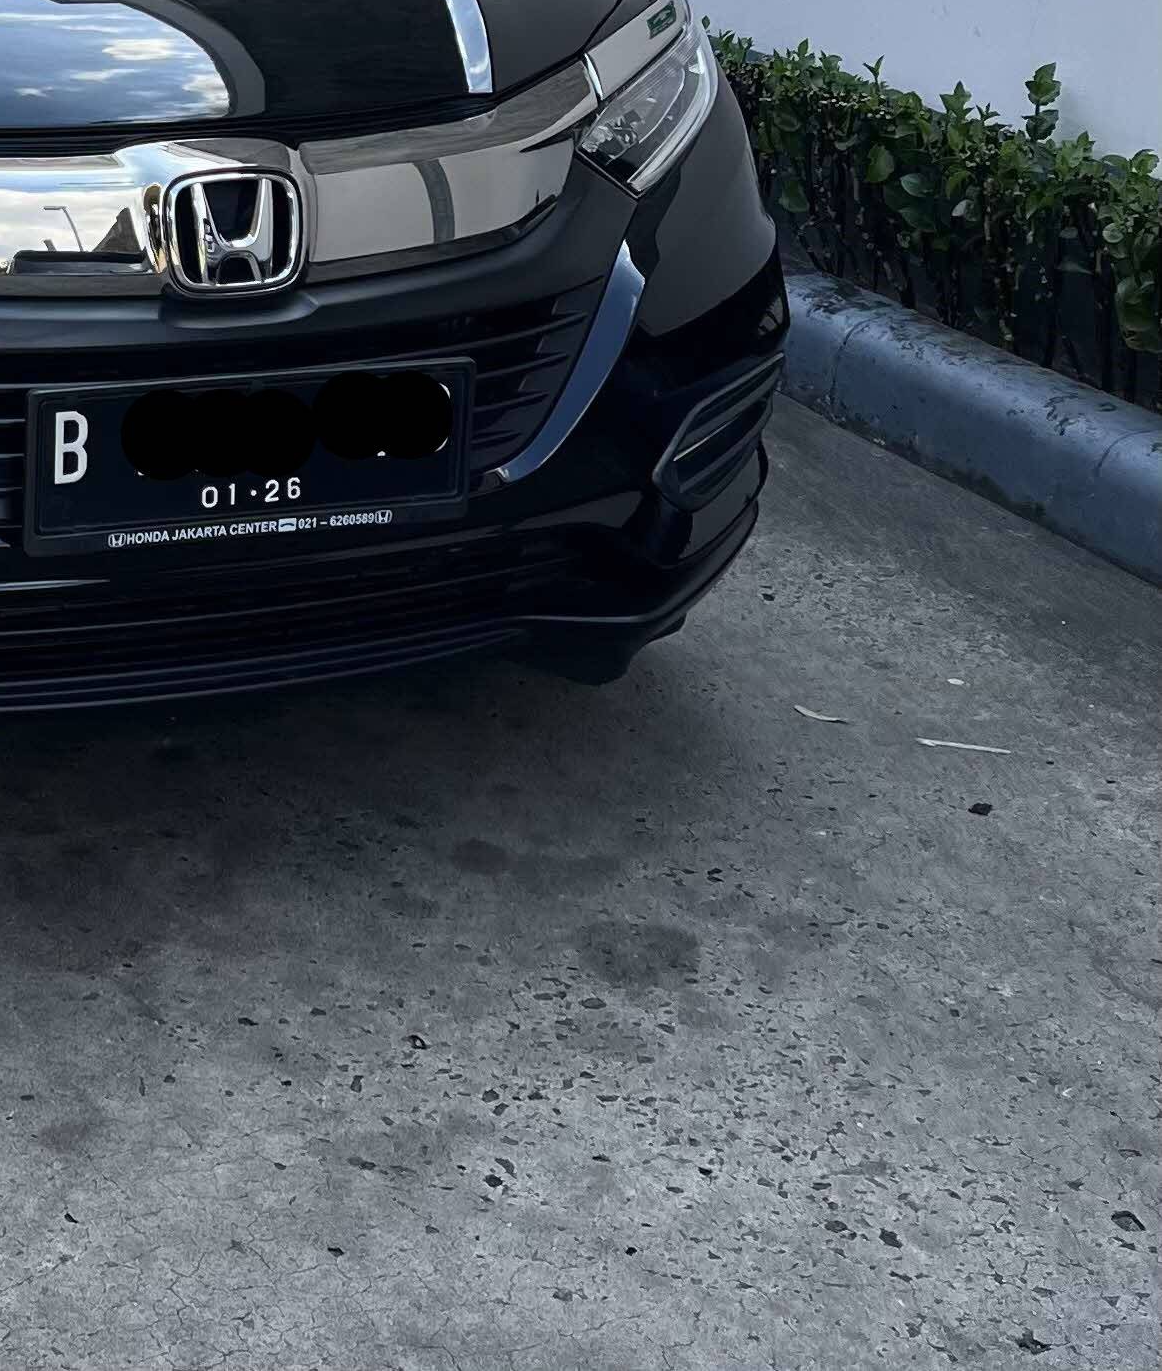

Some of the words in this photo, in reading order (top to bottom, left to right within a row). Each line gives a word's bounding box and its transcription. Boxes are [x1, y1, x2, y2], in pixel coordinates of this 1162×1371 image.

[54, 410, 89, 485] B
[126, 530, 170, 545] HONDA
[171, 525, 227, 541] JAKARTA
[229, 520, 278, 536] CENTER
[297, 517, 317, 530] 021
[329, 512, 375, 527] 6260589
